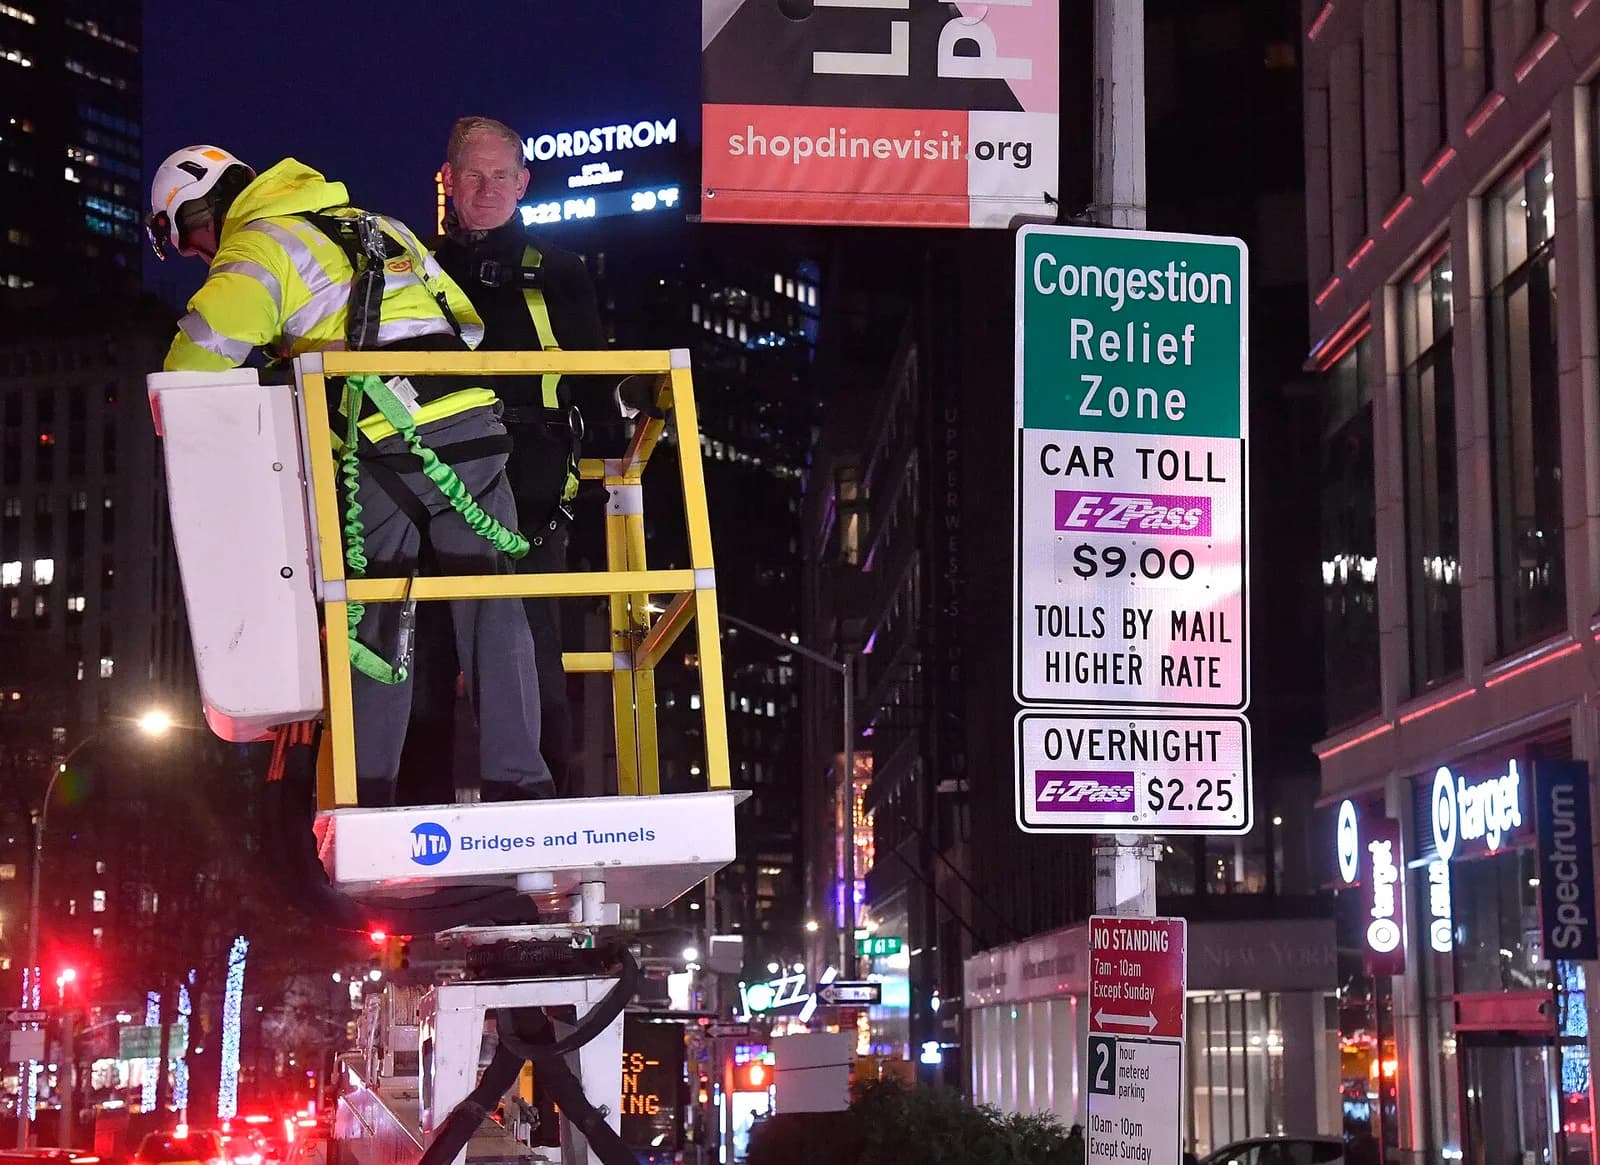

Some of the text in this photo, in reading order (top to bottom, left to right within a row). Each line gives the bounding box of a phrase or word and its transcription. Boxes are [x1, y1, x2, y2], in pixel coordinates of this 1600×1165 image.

[520, 118, 677, 162] NORDSTROM
[728, 125, 1033, 169] shopdinevisit.org
[564, 197, 595, 220] PM
[1033, 252, 1232, 312] Congestion
[1070, 318, 1195, 366] Relief
[1079, 374, 1186, 421] Zone
[1040, 443, 1226, 483] CAR TOLL
[1073, 542, 1195, 581] $9.00
[1035, 604, 1232, 644] TOLLS BY MAIL
[1046, 651, 1222, 688] HIGHER RATE
[1044, 728, 1222, 762] OVERNIGHT
[1148, 776, 1233, 815] $2.25
[1457, 758, 1521, 851] target
[410, 827, 656, 859] MTA Bridges and Tunnels
[1550, 784, 1588, 950] Spectrum
[874, 938, 886, 954] 61
[1094, 928, 1169, 952] NO STANDING
[1094, 958, 1112, 976] 7am
[1119, 959, 1142, 977] 10am
[1093, 980, 1155, 1005] Except Sunday
[1095, 1042, 1110, 1090] 2
[1119, 1045, 1136, 1061] hour
[1119, 1064, 1150, 1080] metered
[1119, 1083, 1145, 1103] parking
[1091, 1114, 1112, 1133] 10am
[1120, 1117, 1143, 1140] 10pm
[1090, 1138, 1152, 1165] Except Sunday
